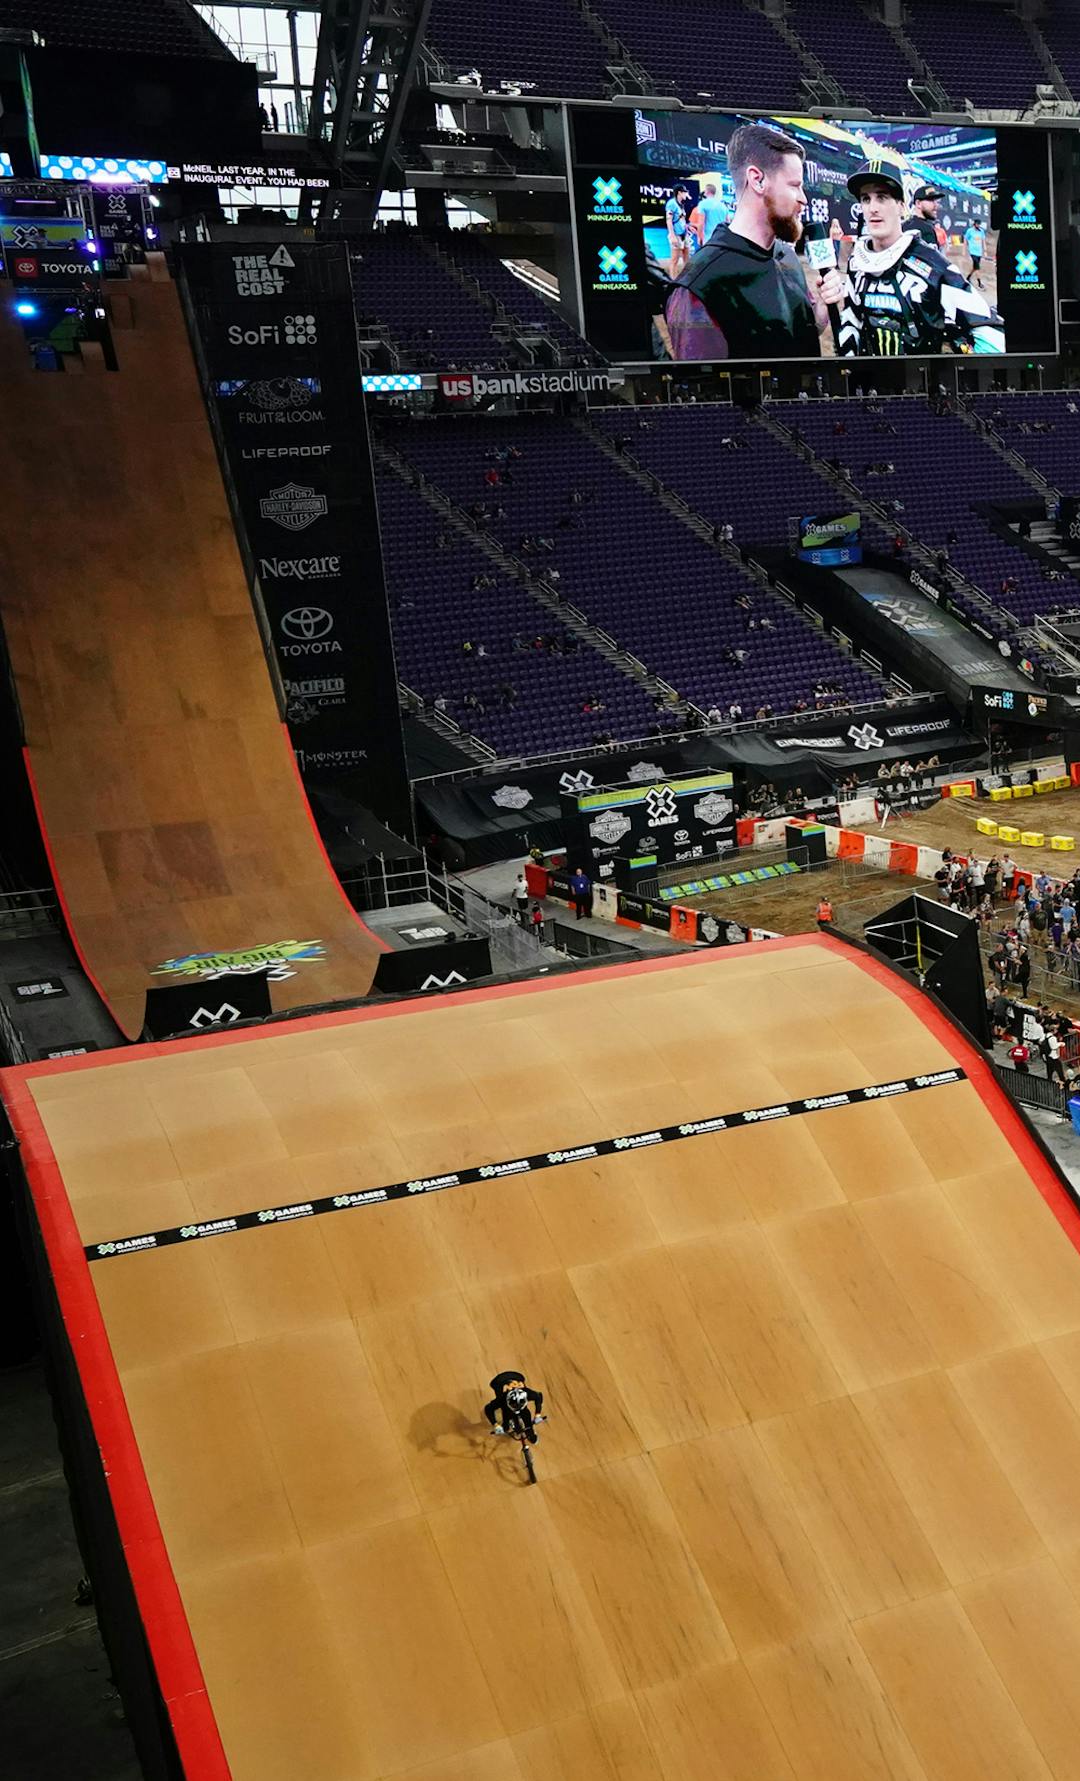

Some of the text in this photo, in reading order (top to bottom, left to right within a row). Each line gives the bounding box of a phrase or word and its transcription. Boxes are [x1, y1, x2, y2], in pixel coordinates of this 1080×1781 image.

[217, 166, 239, 174] LAST
[268, 168, 277, 176] IN
[278, 168, 296, 177] THE
[184, 174, 234, 184] INAUGURAL
[267, 178, 286, 186] YOU
[287, 178, 305, 187] HAD
[306, 179, 330, 188] BEEN
[594, 205, 625, 214] GAMES
[587, 214, 632, 222] MINNEAPOLIS
[1013, 215, 1037, 223] GAMES
[1007, 223, 1044, 231] MINNEAPOLIS
[41, 262, 94, 274] TOYOTA
[231, 255, 269, 269] THE
[234, 267, 285, 283] REAL
[599, 274, 630, 282] GAMES
[236, 281, 286, 297] COST
[593, 283, 638, 291] MINNEAPOLIS
[228, 325, 280, 346] SoFi
[239, 411, 274, 424] FRUIT
[241, 445, 333, 459] LIFEPROOF
[259, 556, 341, 580] Nexcare
[280, 640, 343, 657] TOYOTA
[984, 693, 1002, 708] SoFi
[885, 719, 951, 737] LIFEPROOF
[648, 815, 679, 828] GAMES
[693, 1118, 726, 1131] GAMES
[629, 1132, 662, 1145] GAMES
[562, 1146, 597, 1159] GAMES
[494, 1160, 530, 1173] GAMES
[422, 1174, 459, 1188] GAMES
[349, 1190, 387, 1203] GAMES
[274, 1203, 313, 1217] GAMES
[198, 1219, 237, 1233] GAMES
[116, 1235, 156, 1249] GAMES
